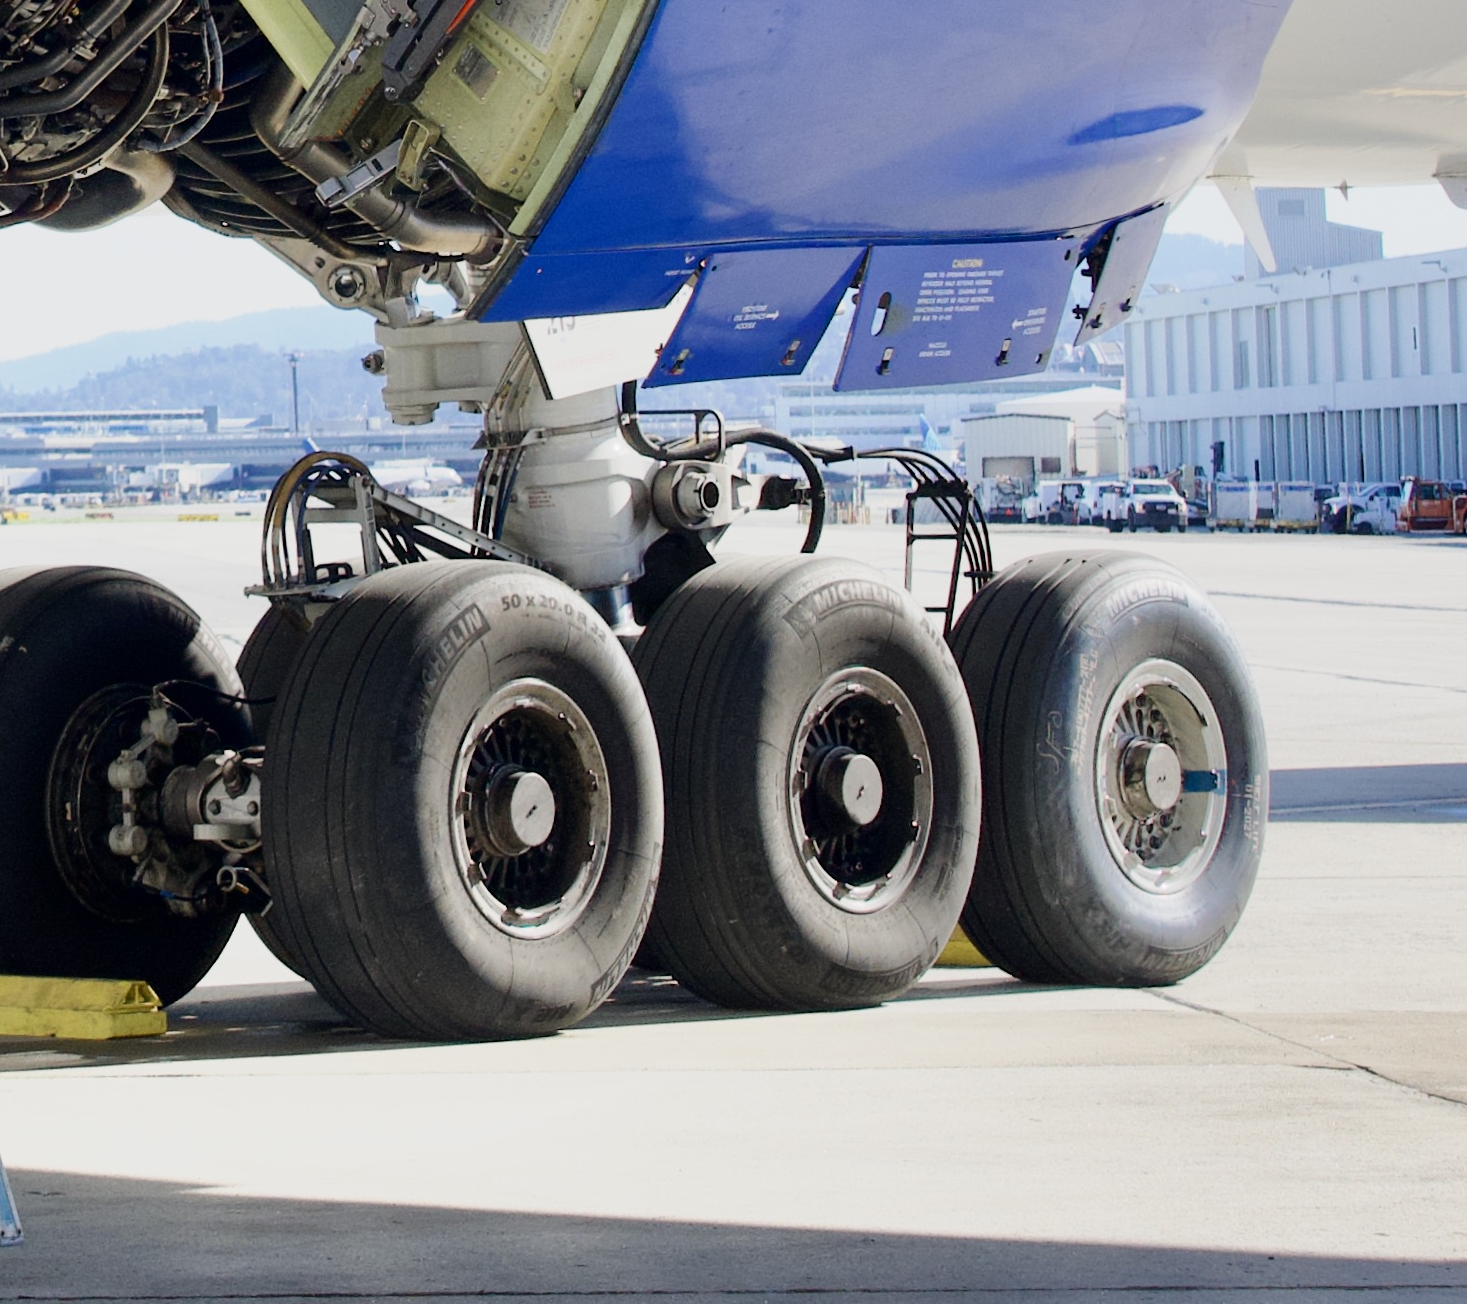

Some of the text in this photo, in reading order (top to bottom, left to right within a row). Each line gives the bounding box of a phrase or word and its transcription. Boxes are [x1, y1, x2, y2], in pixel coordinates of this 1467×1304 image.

[952, 258, 983, 269] CAUTION
[501, 594, 521, 612] 50
[813, 581, 904, 614] MICHELIN
[1105, 580, 1188, 617] MICHELIN
